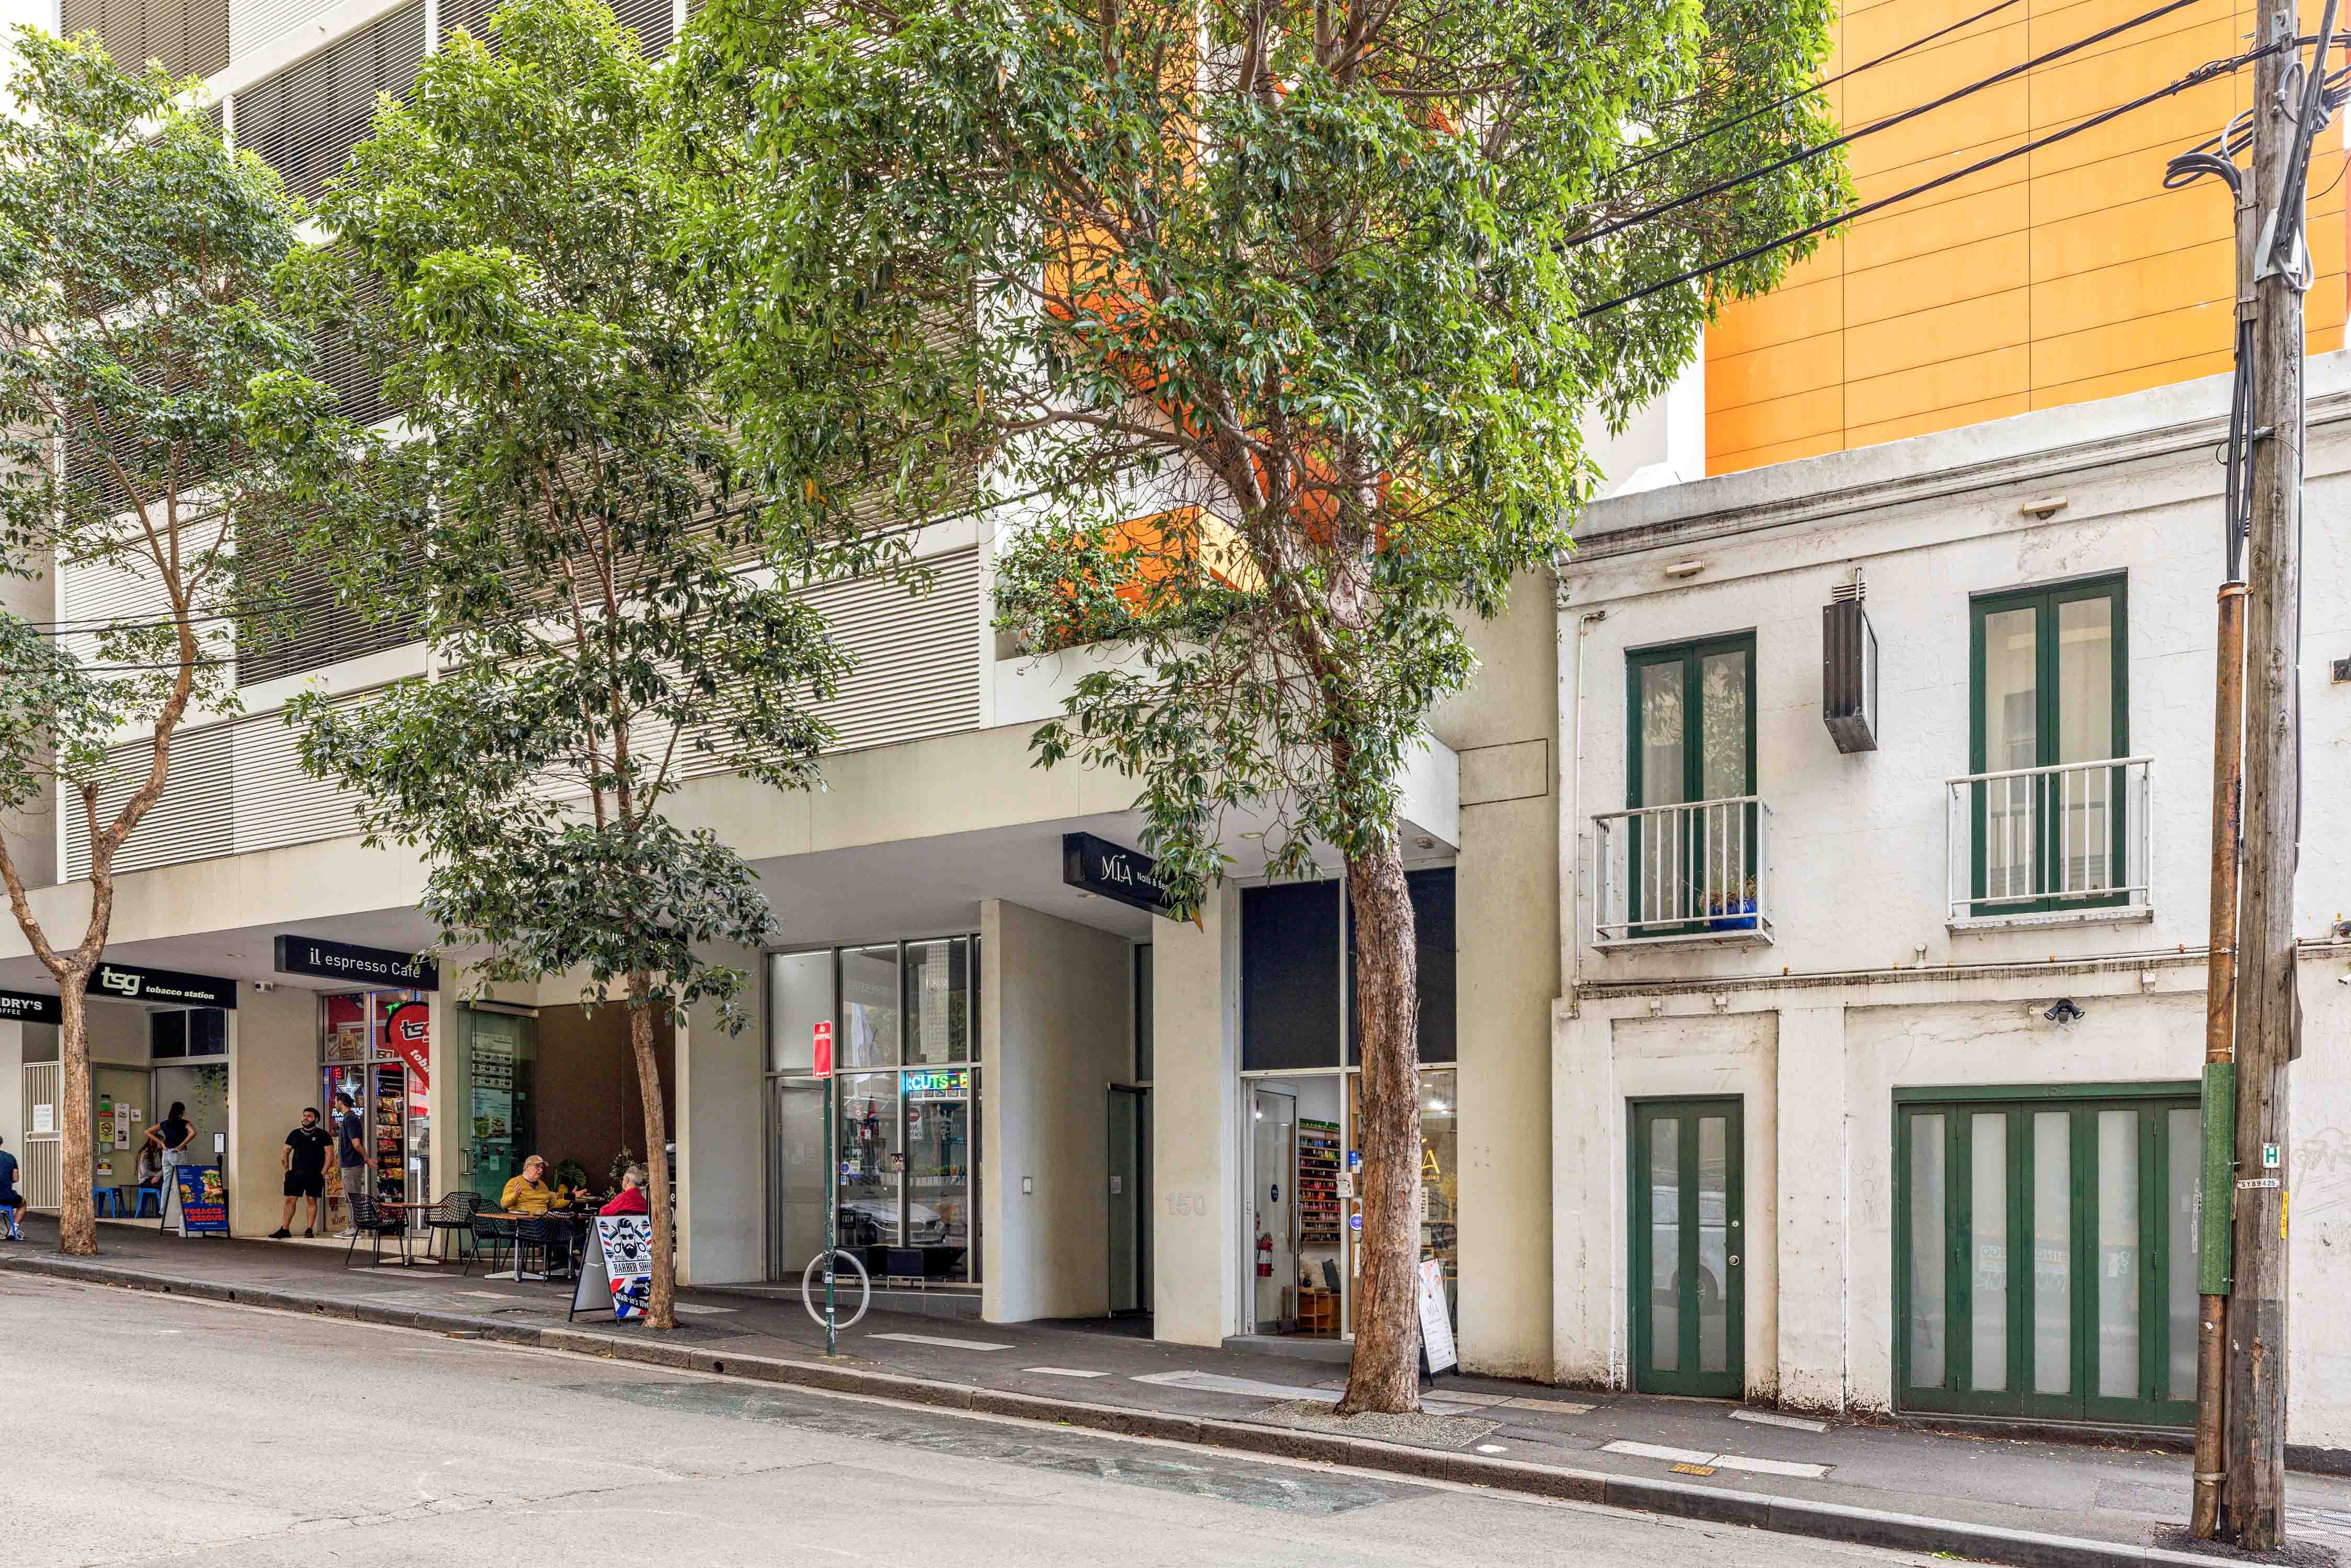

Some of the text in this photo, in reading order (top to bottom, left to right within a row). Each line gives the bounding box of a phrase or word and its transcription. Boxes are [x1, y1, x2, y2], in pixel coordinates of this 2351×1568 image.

[325, 955, 387, 973] espresso
[101, 966, 141, 996] tsg
[146, 986, 214, 999] tobacco station
[0, 997, 42, 1011] DRY'S
[2266, 1148, 2277, 1163] H
[842, 1214, 854, 1223] CREW
[614, 1262, 638, 1273] BARBER
[616, 1292, 639, 1305] Walk-in's
